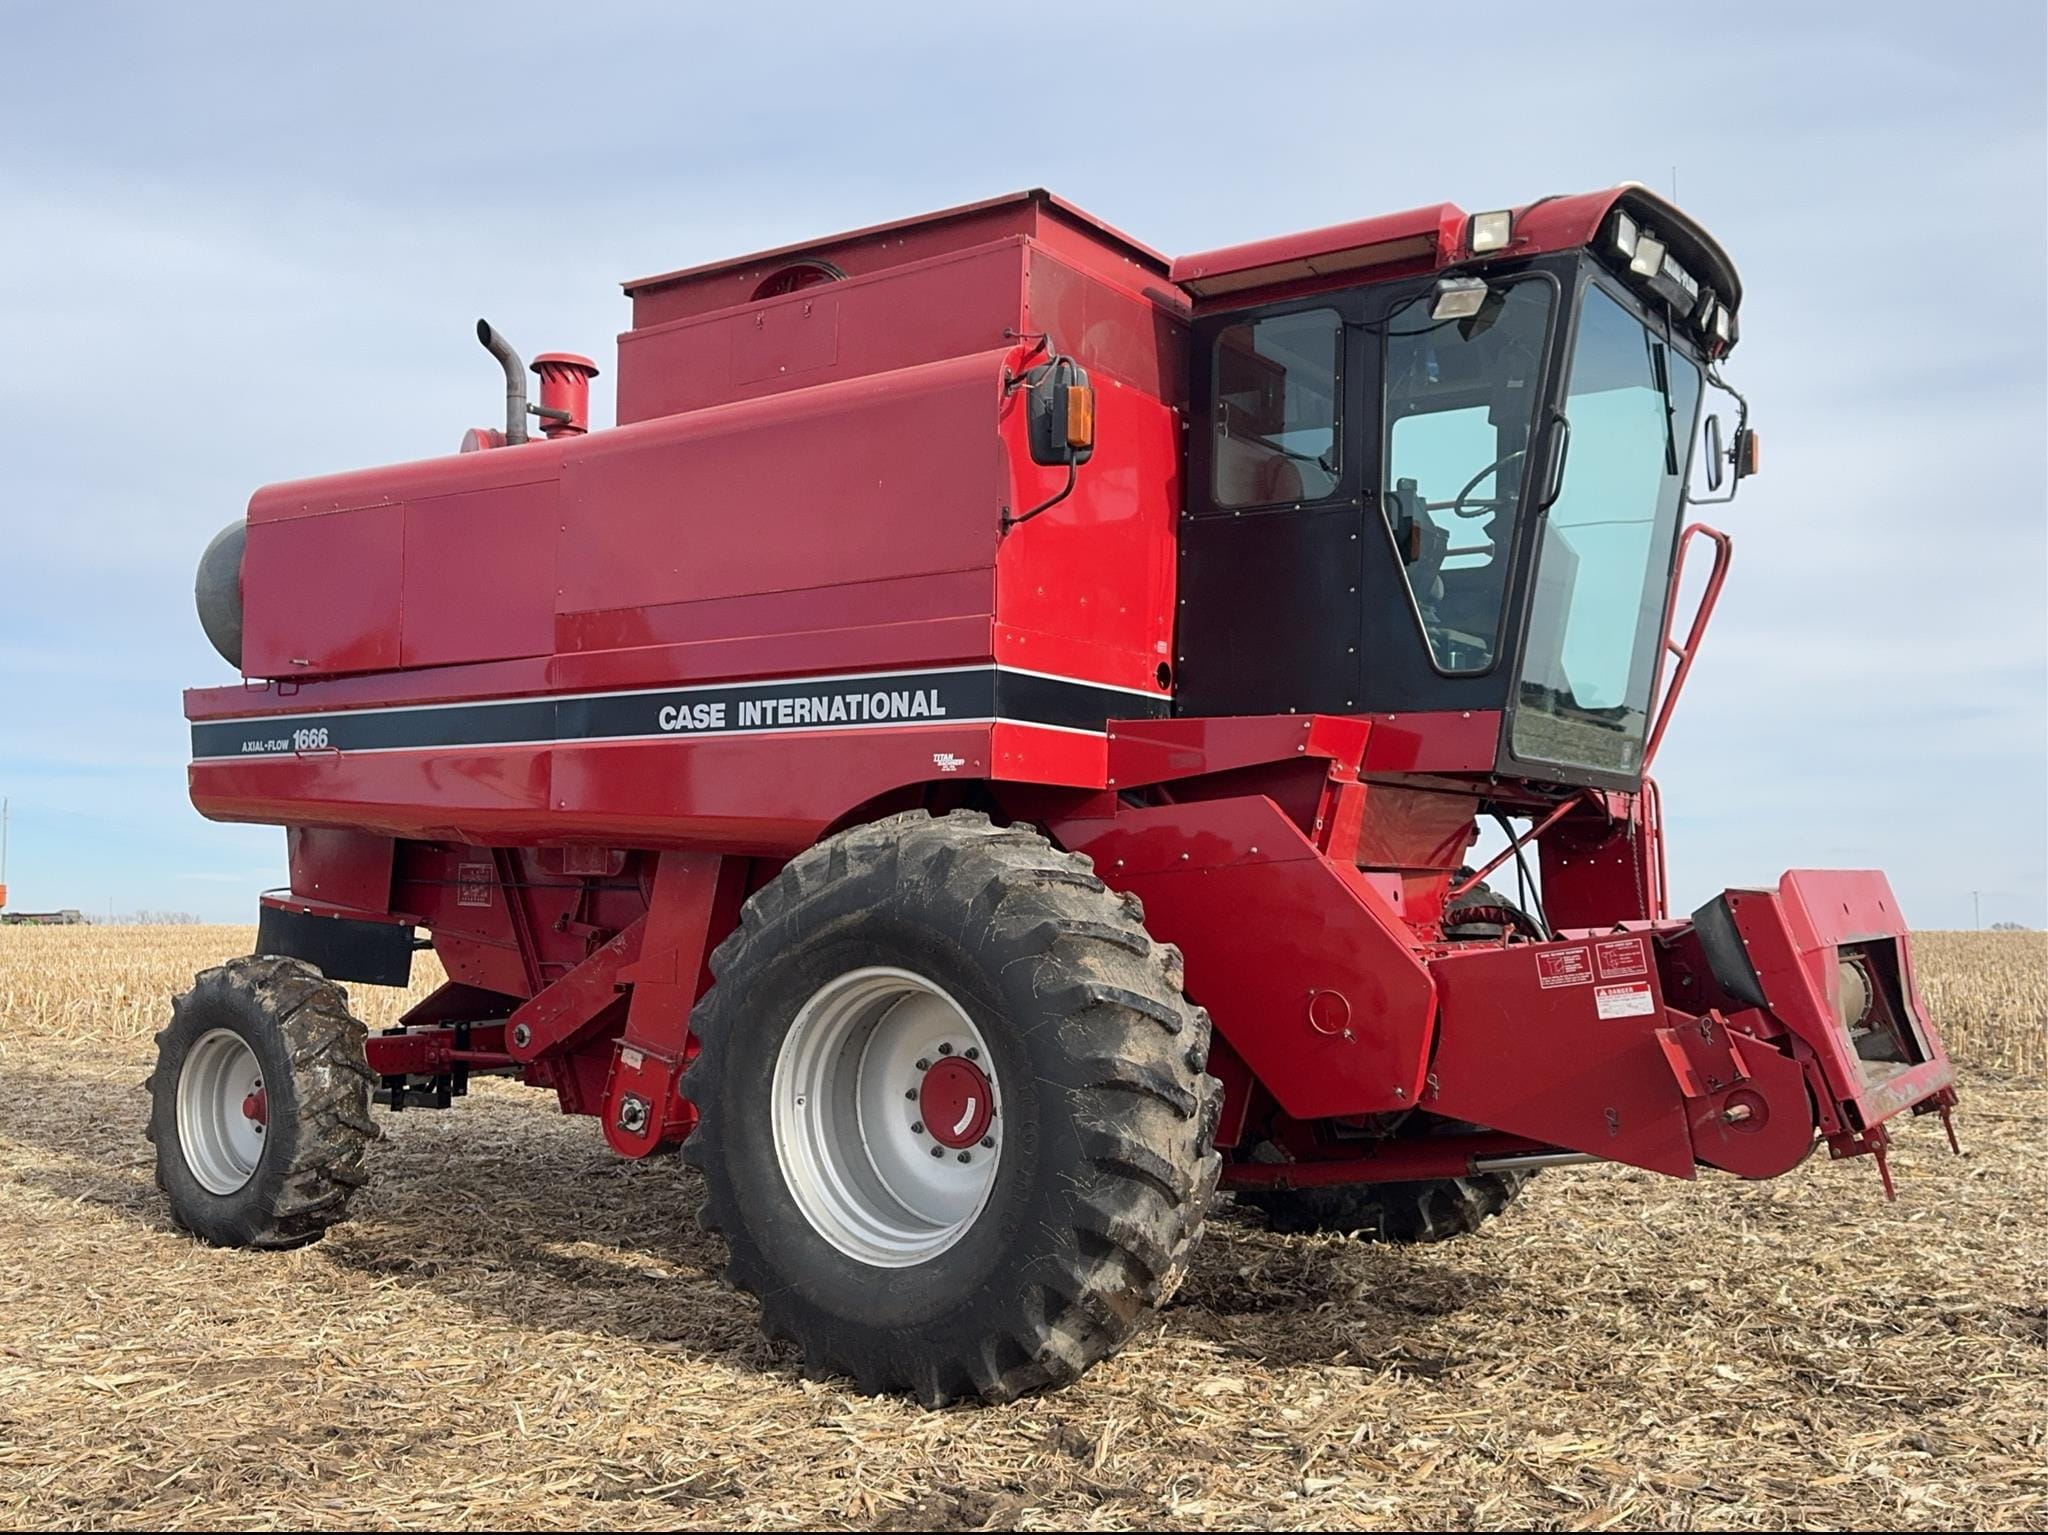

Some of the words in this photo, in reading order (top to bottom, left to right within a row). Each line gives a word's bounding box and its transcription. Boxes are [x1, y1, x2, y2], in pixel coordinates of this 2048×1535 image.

[658, 703, 726, 731] CASE
[738, 689, 946, 727] INTERNATIONAL
[293, 728, 328, 750] 1666
